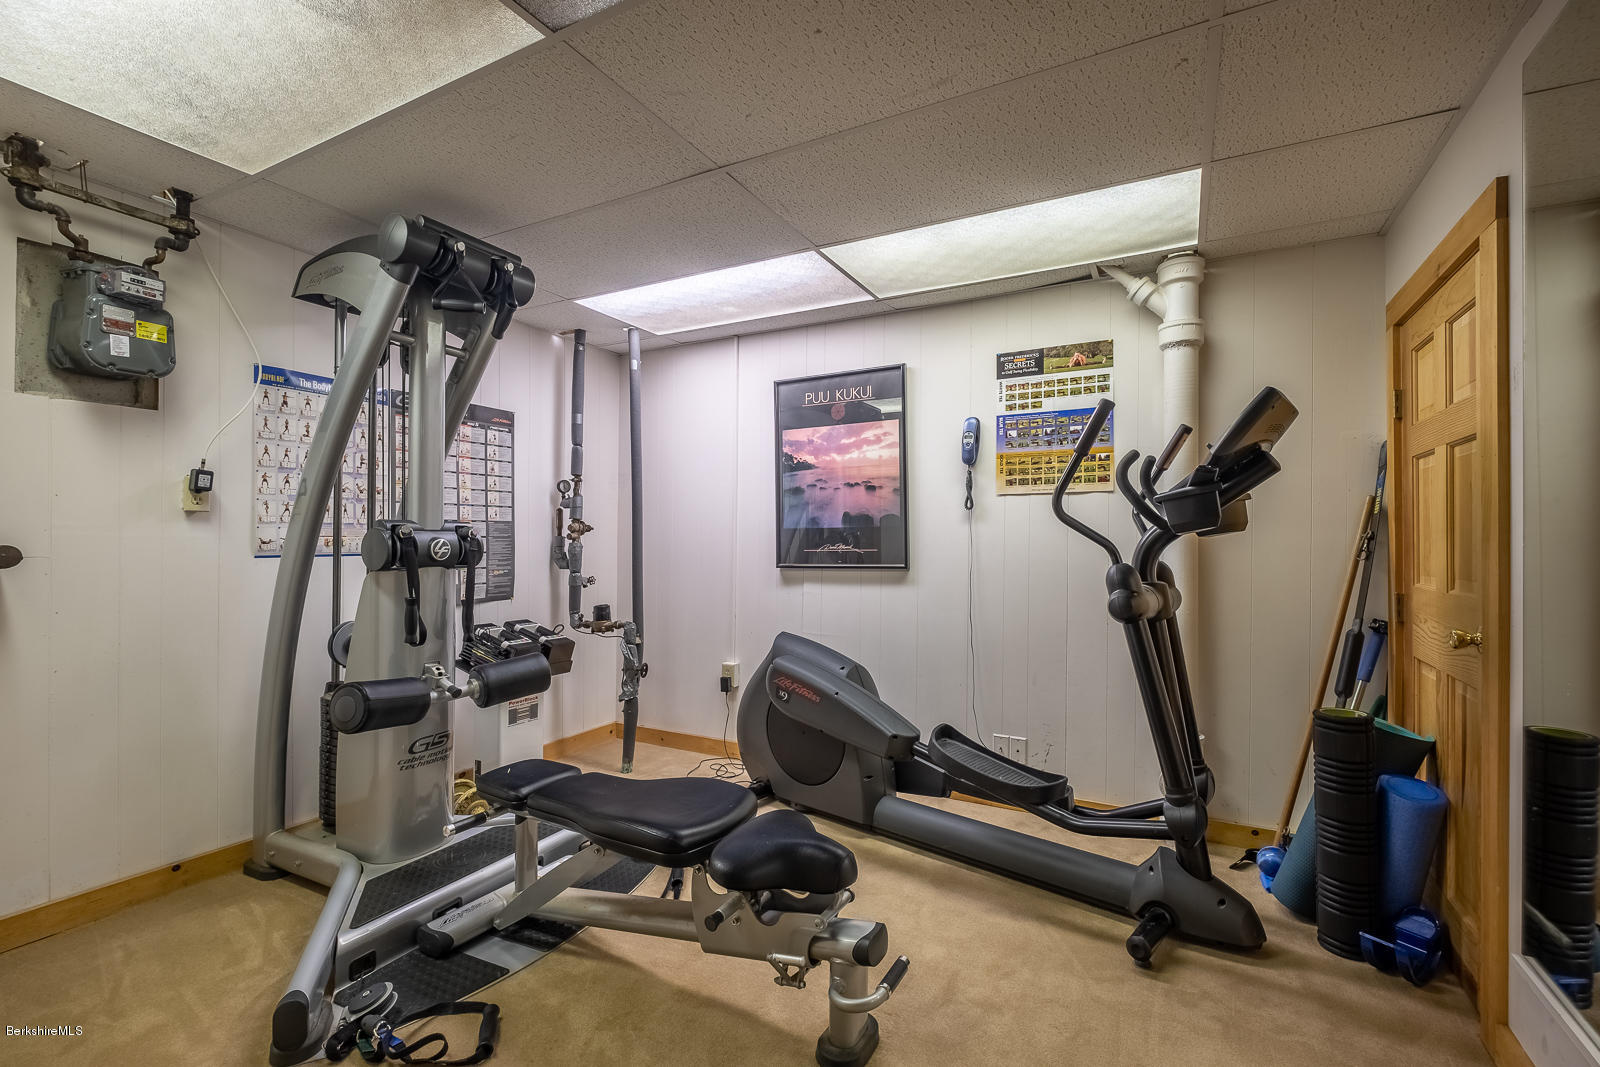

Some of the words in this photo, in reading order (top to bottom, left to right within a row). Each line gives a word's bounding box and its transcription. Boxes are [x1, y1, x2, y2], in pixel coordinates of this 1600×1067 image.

[1004, 359, 1035, 369] SECRETS
[299, 377, 312, 389] The
[805, 390, 830, 404] PUU
[835, 385, 872, 401] KUKUI
[397, 754, 426, 766] cable
